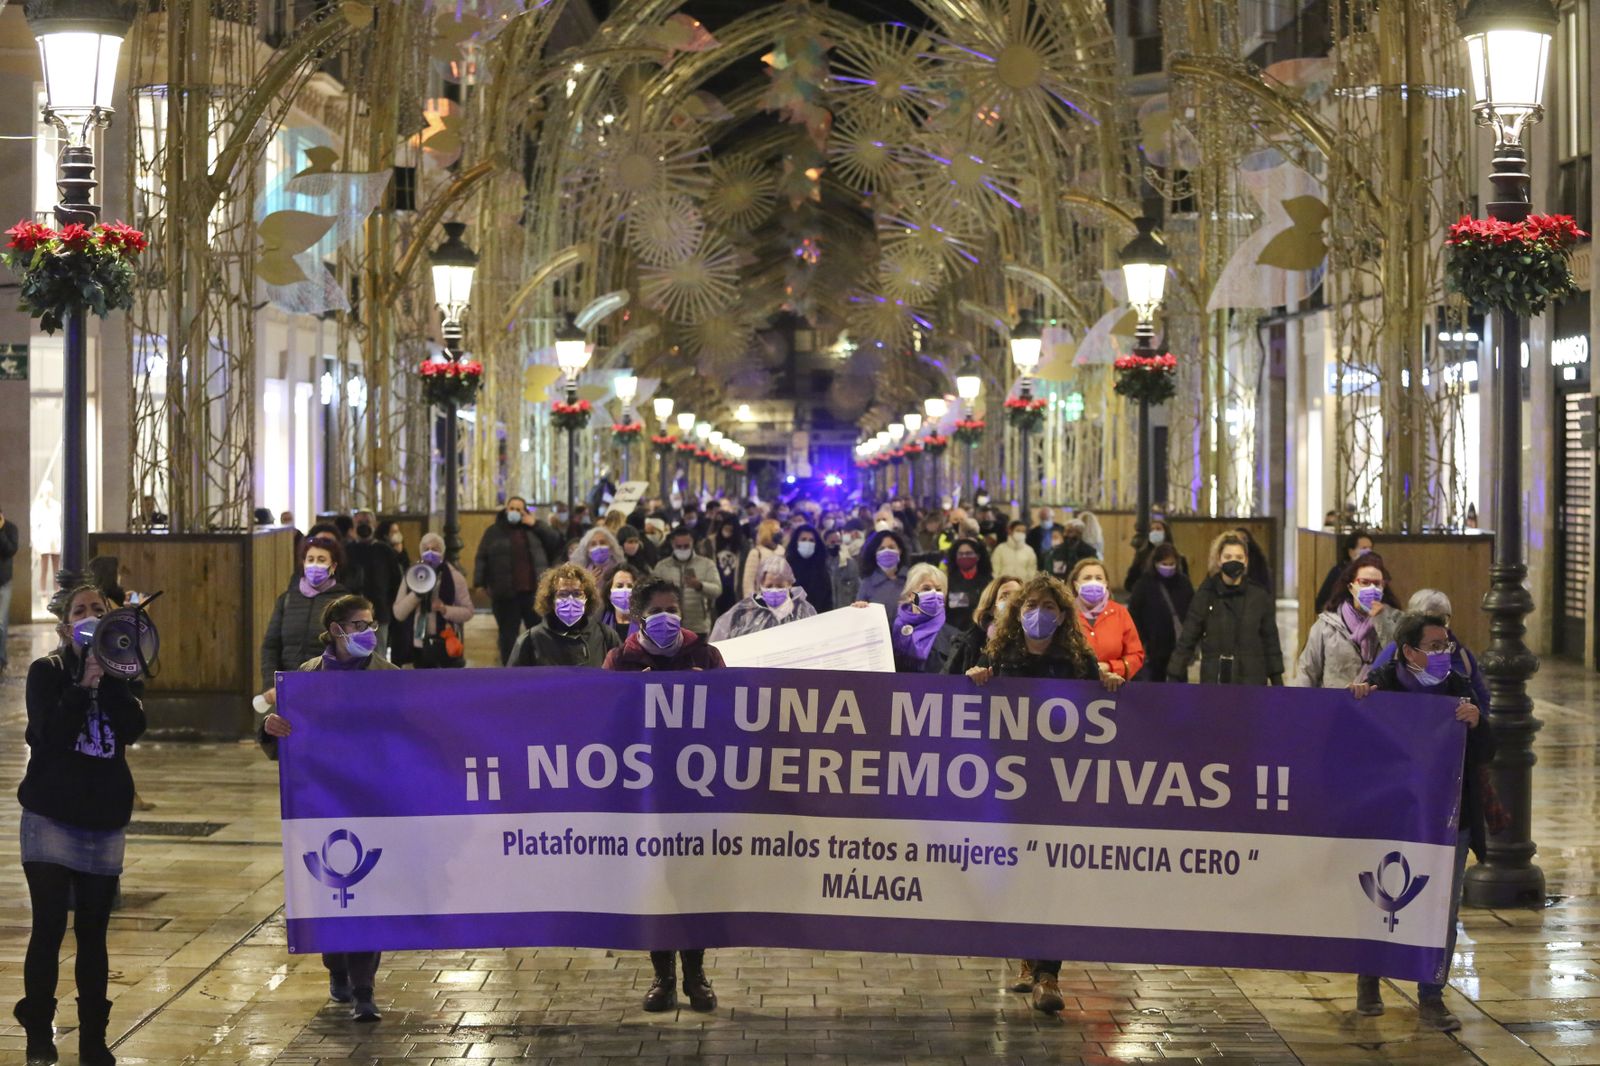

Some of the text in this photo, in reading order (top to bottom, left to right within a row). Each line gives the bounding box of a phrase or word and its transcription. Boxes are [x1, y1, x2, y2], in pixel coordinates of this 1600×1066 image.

[644, 683, 1117, 744] NI UNA MENOS
[527, 743, 654, 790] NOS
[676, 744, 1027, 800] QUEREMOS
[1050, 757, 1231, 809] VIVAS
[1256, 765, 1290, 811] !!
[502, 827, 629, 857] Plataforma
[635, 831, 705, 857] contra
[711, 828, 743, 857] los
[750, 829, 820, 859] malos
[827, 834, 898, 862] tratos
[904, 842, 919, 863] a
[925, 837, 1019, 872] mujeres
[1045, 842, 1172, 873] VIOLENCIA
[1179, 847, 1241, 876] CERO
[822, 867, 923, 902] MÁLAGA
